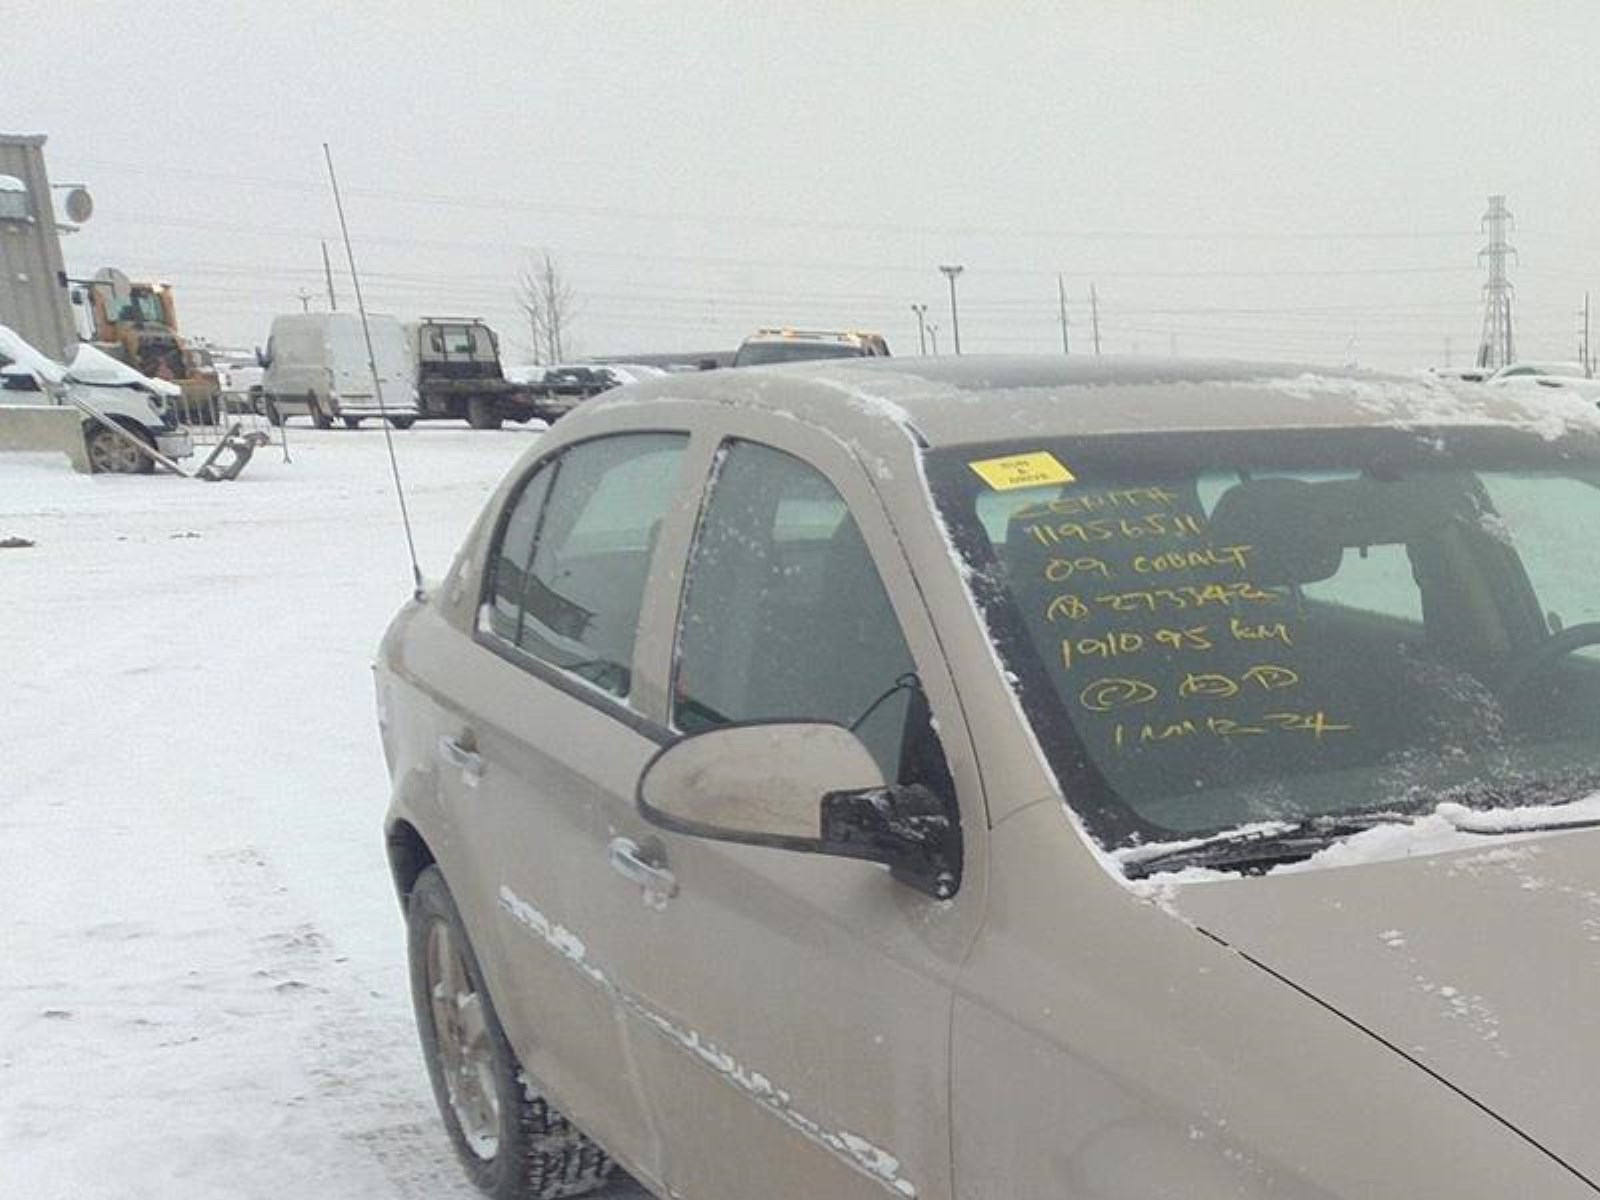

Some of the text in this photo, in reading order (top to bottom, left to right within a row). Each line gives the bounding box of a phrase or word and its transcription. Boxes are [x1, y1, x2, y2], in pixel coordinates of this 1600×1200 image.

[1026, 512, 1202, 547] 11956511
[1045, 544, 1253, 583] 09 COBALT
